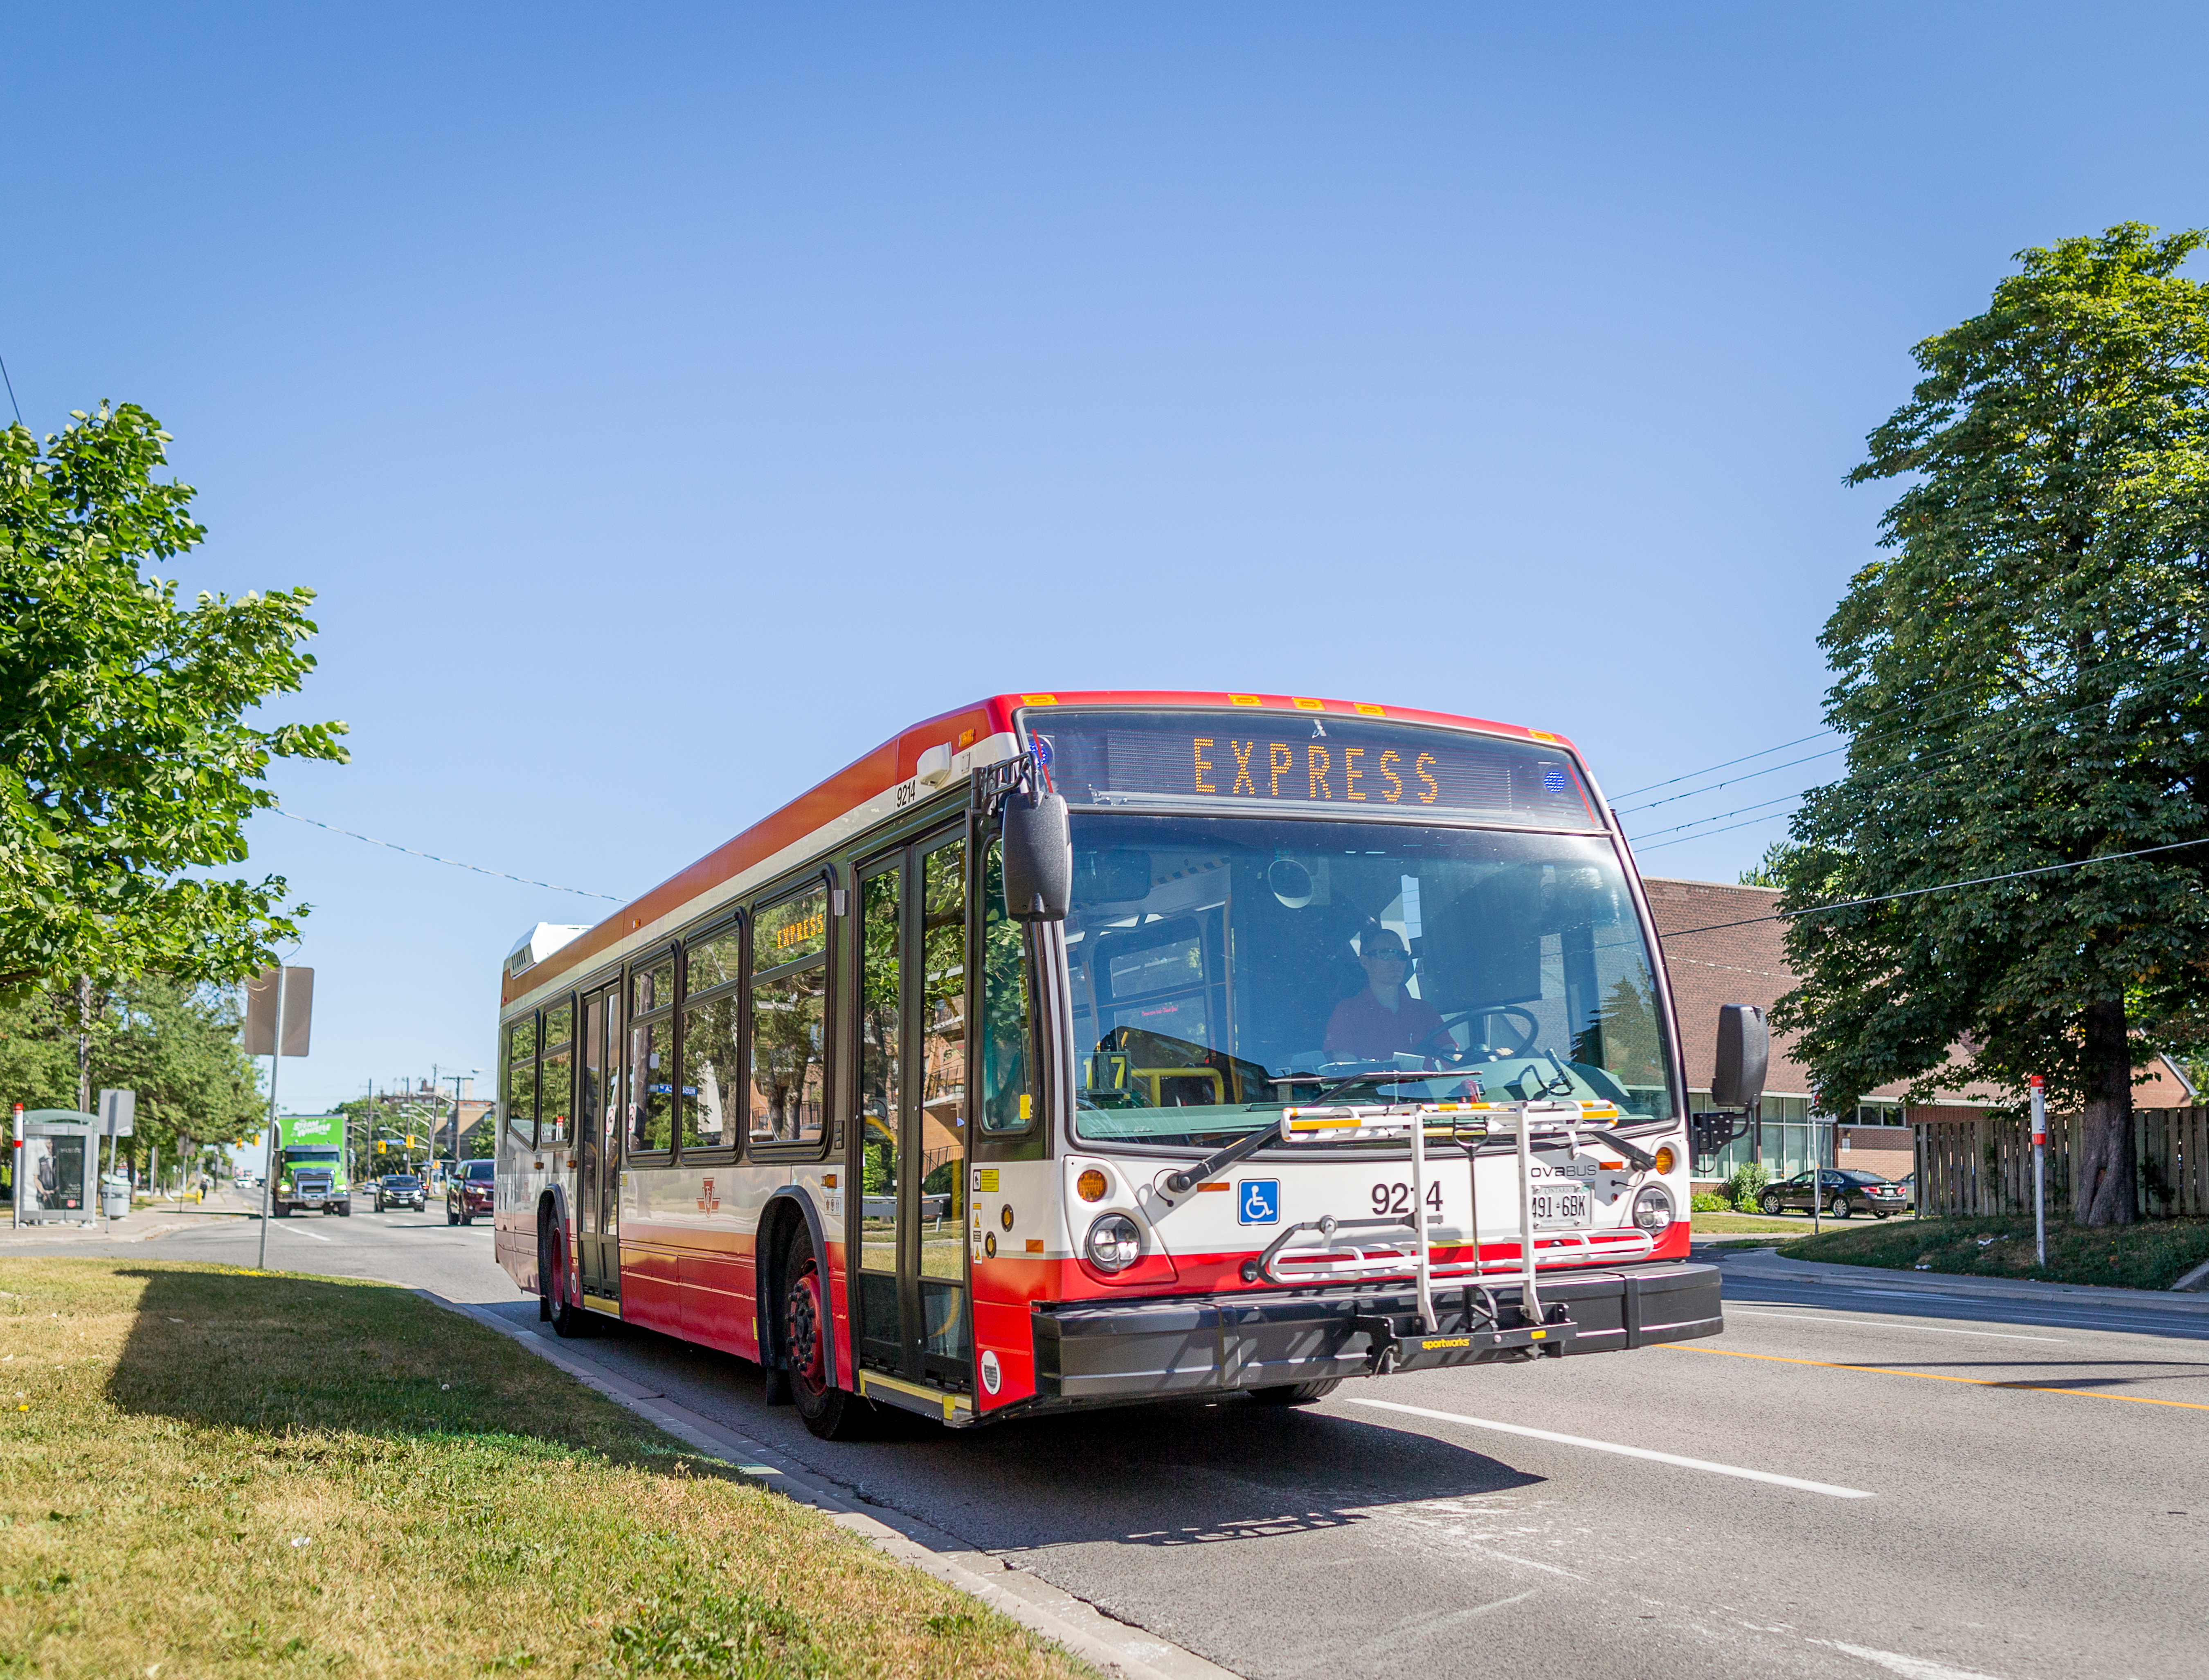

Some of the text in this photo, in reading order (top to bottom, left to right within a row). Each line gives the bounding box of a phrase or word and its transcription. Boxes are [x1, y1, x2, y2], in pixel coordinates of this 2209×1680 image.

[1193, 738, 1438, 804] EXPRESS
[897, 779, 916, 808] 9214
[777, 913, 824, 950] EXPRESS
[1531, 1165, 1597, 1177] ovaBUS
[1372, 1181, 1443, 1215] 924
[1422, 1338, 1470, 1350] sportworks
